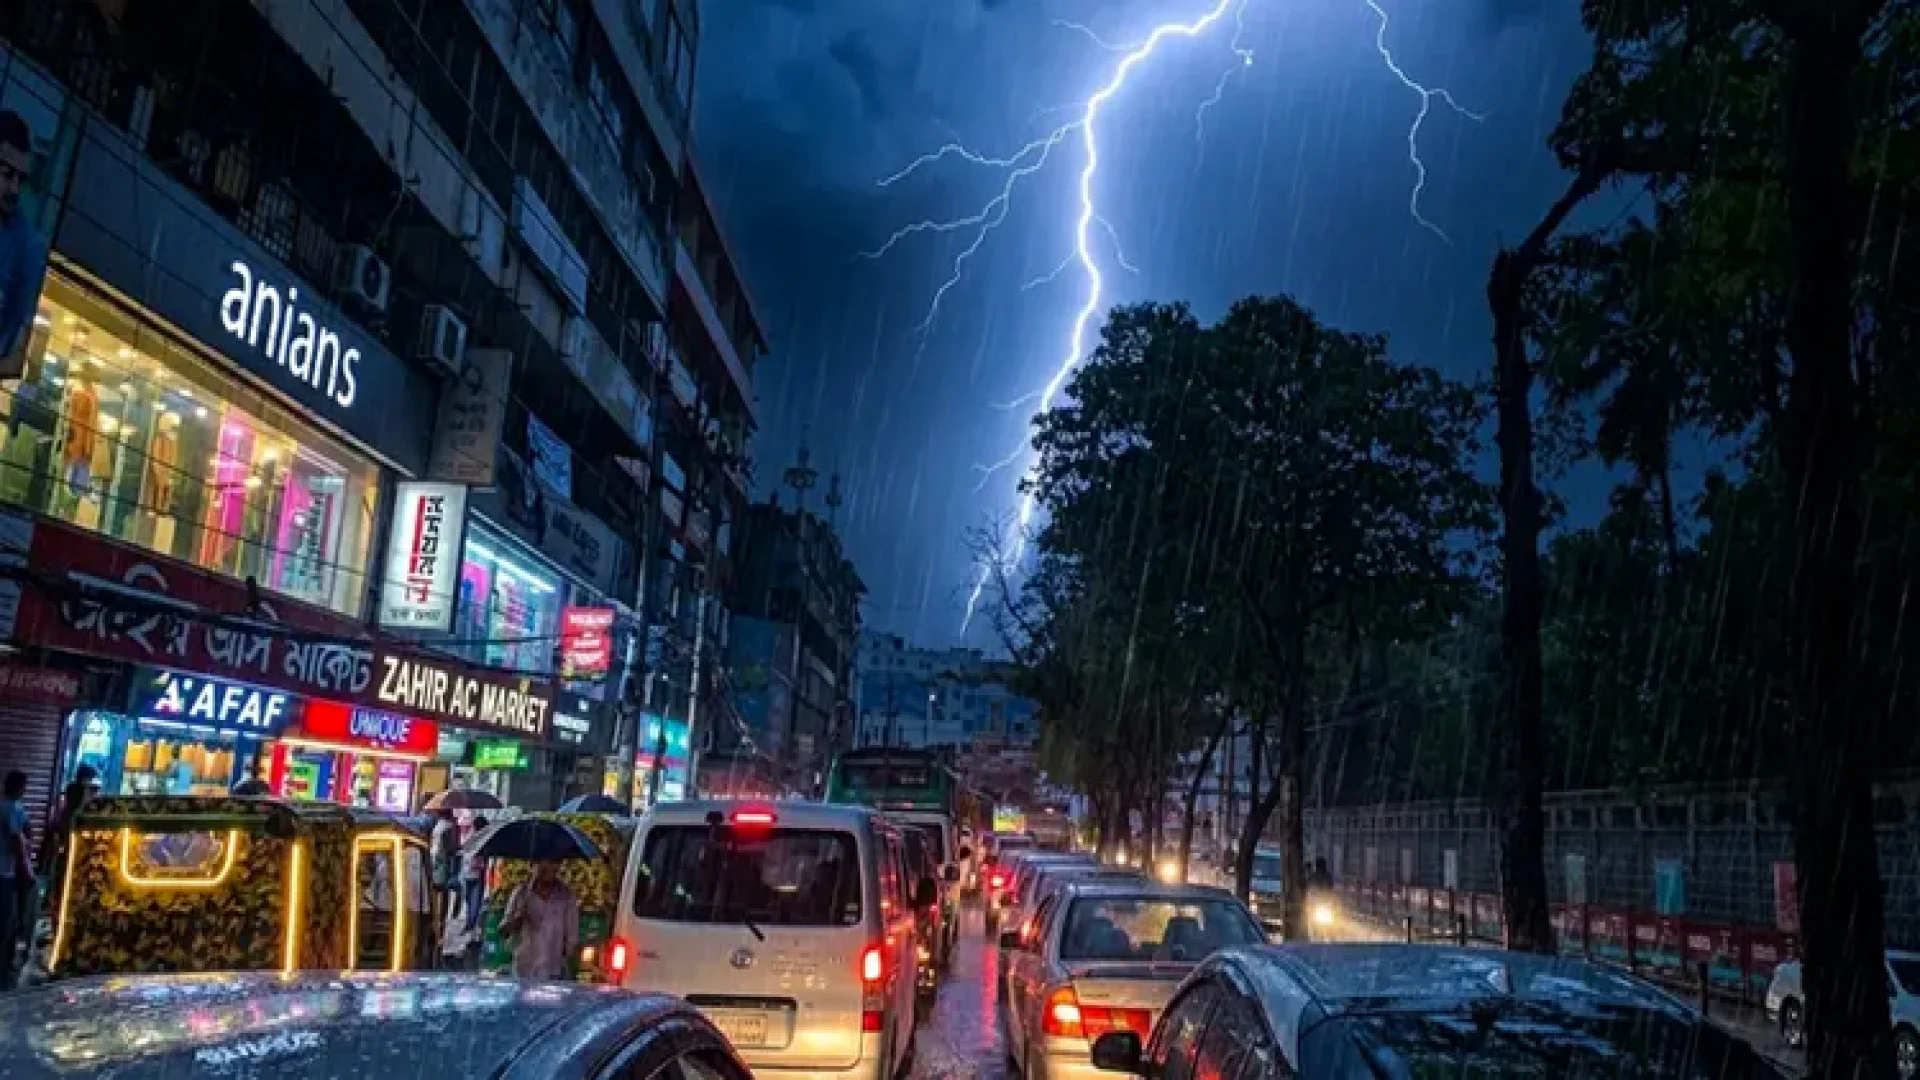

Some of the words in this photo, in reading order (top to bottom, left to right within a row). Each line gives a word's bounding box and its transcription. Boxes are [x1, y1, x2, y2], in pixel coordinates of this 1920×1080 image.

[379, 656, 448, 712] ZAHIR
[449, 676, 479, 720] AC
[479, 684, 548, 734] MARKET
